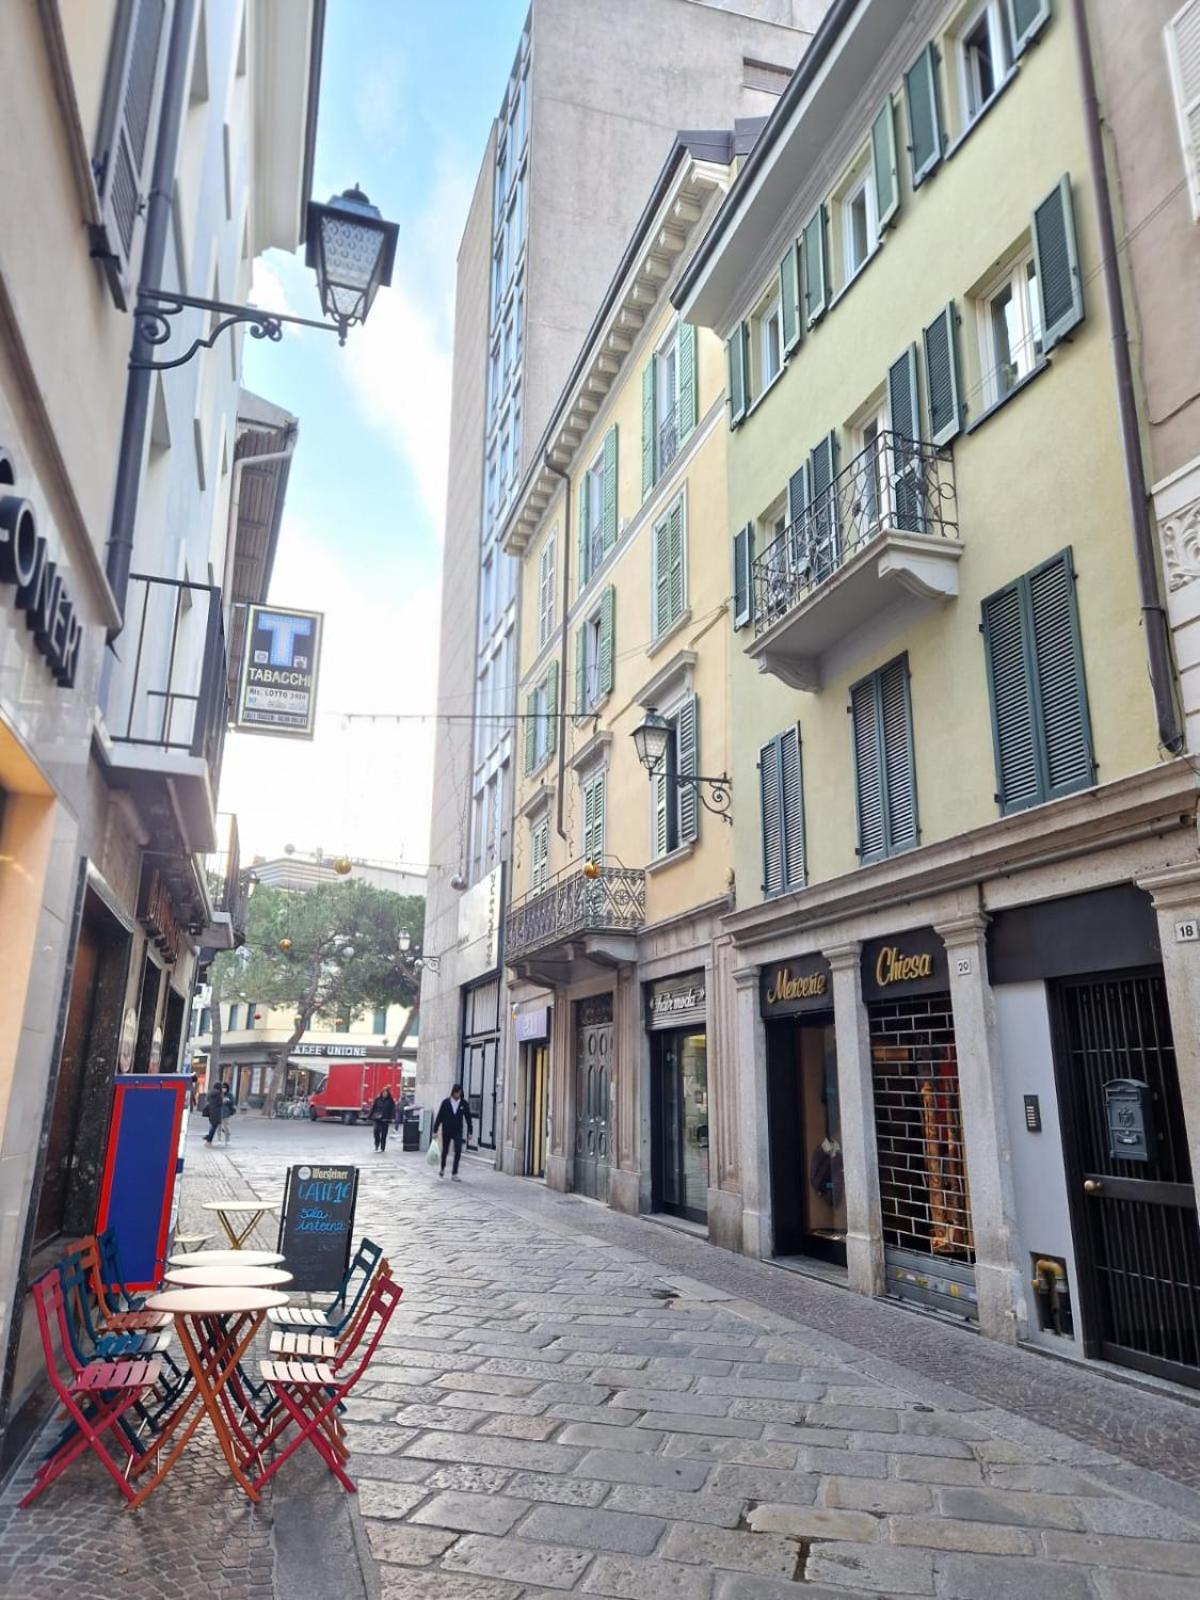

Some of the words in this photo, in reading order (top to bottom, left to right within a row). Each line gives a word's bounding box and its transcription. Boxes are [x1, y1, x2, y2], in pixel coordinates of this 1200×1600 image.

[258, 612, 311, 667] T
[249, 668, 312, 686] TABACCHI
[1180, 924, 1194, 938] 18
[876, 946, 932, 987] Chiesa
[958, 961, 969, 973] 20
[767, 968, 826, 1003] Mercerie
[327, 1045, 368, 1057] UNIONE
